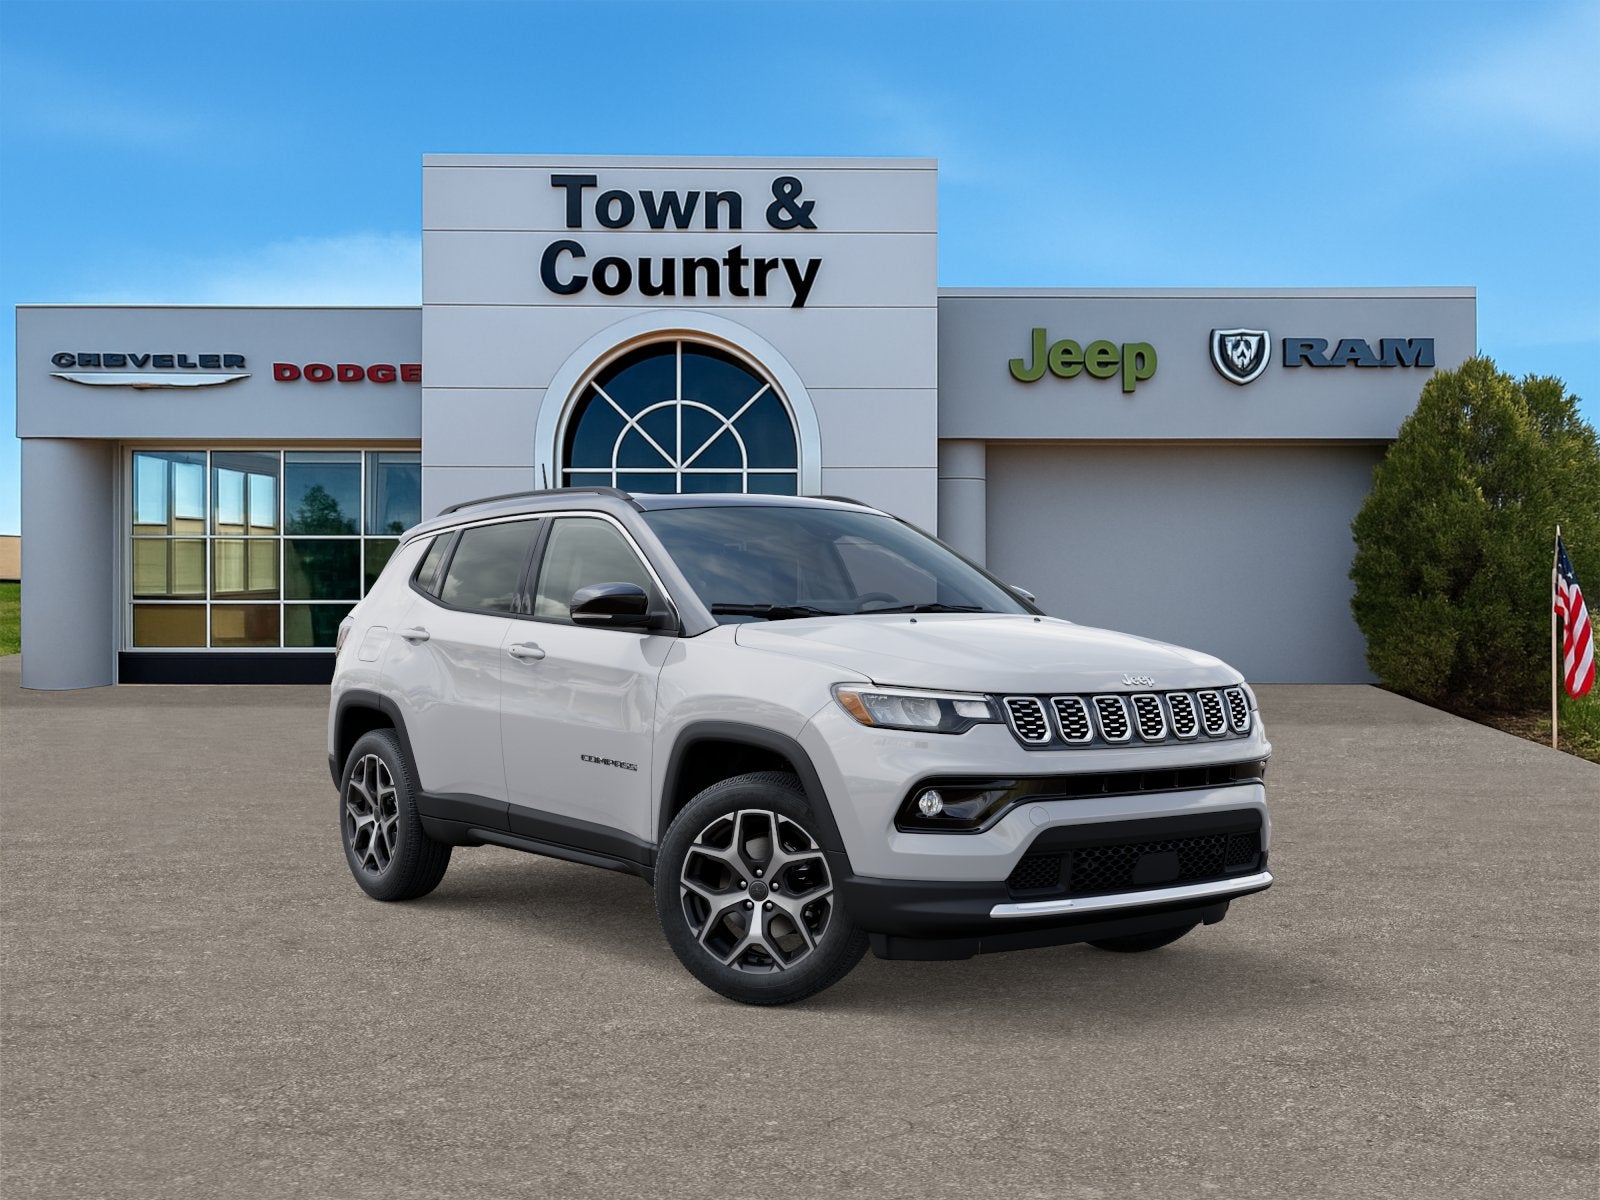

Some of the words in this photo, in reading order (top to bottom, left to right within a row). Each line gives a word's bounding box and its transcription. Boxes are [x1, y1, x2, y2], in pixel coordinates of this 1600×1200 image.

[551, 174, 742, 229] Town
[765, 176, 818, 230] &
[540, 239, 823, 308] Country
[1008, 328, 1158, 393] Jeep
[1282, 337, 1436, 368] RAM
[272, 362, 422, 383] DODGE
[1121, 673, 1155, 688] Jeep
[580, 754, 638, 772] COMPASS
